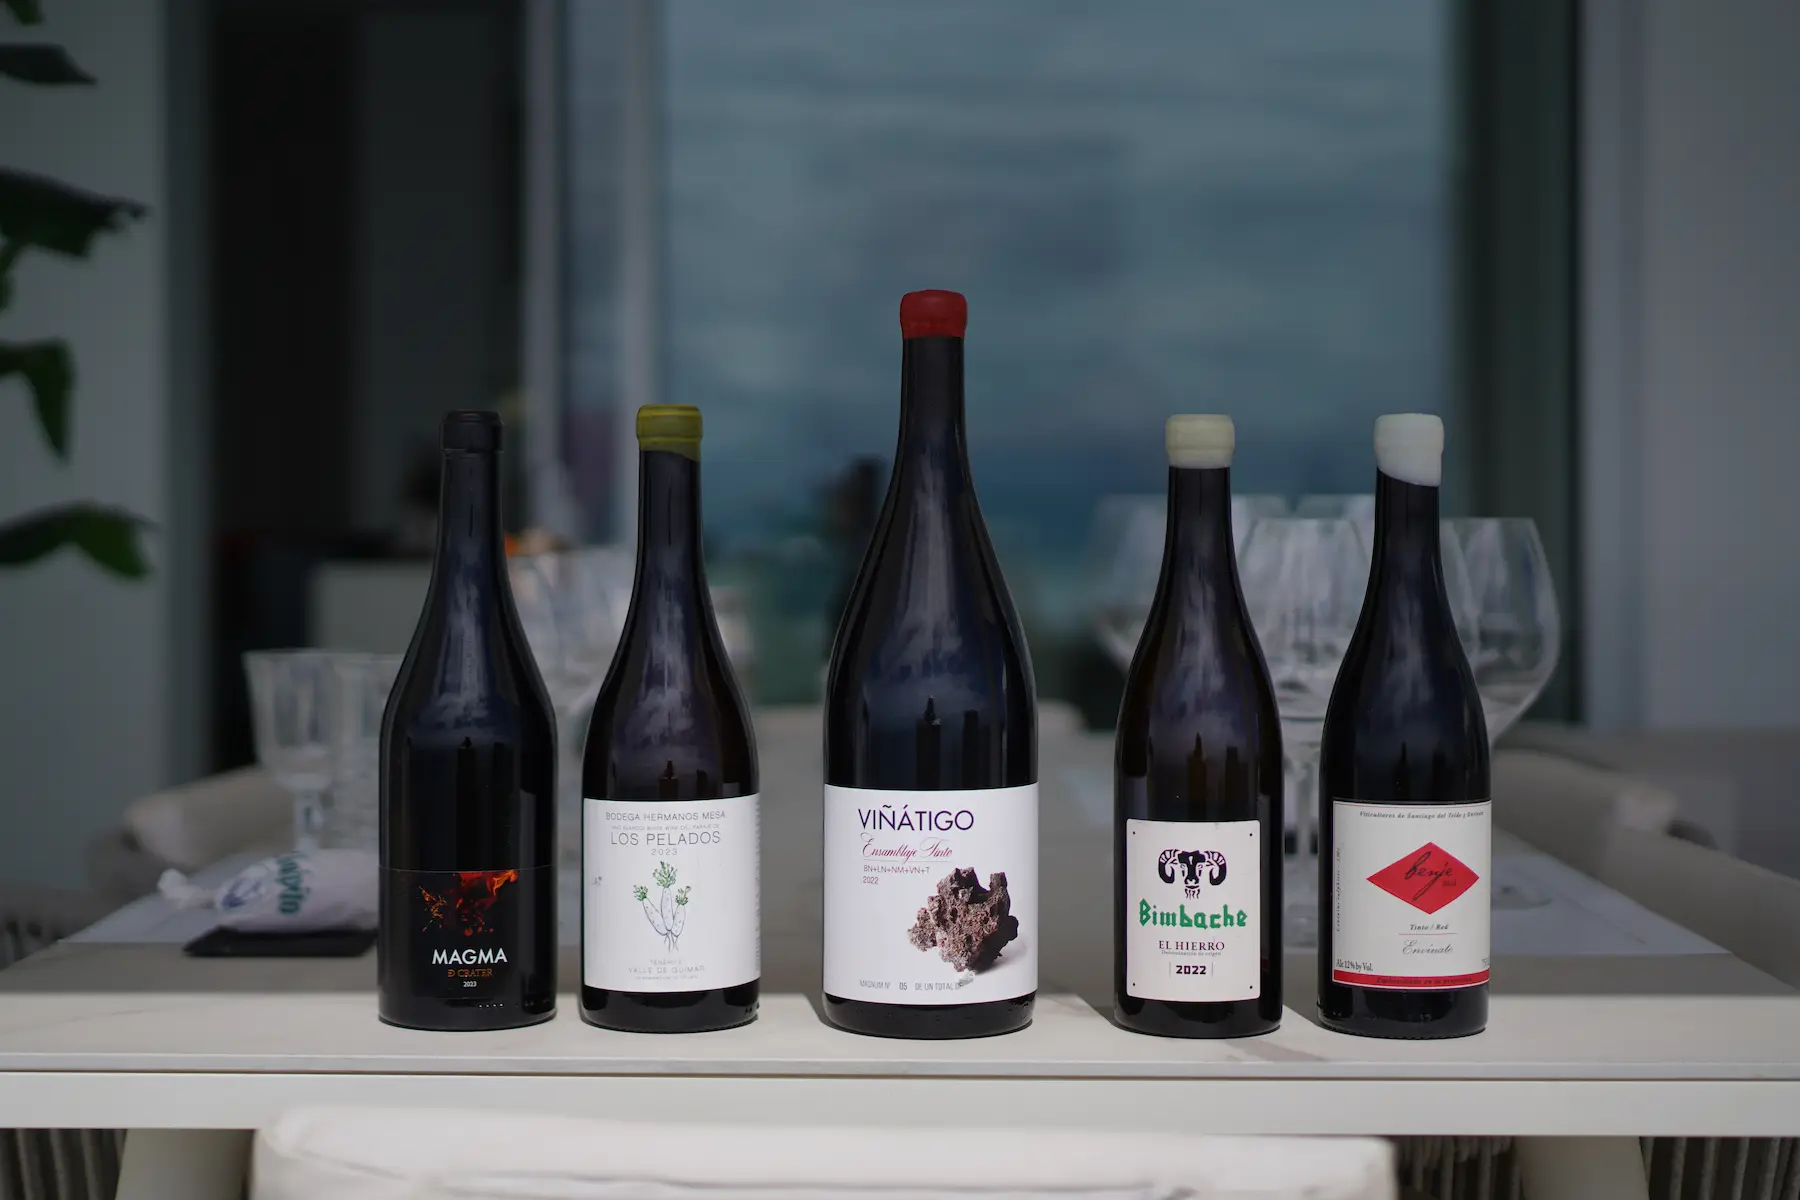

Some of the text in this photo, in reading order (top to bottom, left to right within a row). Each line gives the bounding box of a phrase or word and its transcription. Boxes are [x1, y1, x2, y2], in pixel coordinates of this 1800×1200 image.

[605, 810, 726, 821] BODEGA HERMANOS MESA
[857, 804, 975, 831] VIÑÁTIGO
[610, 830, 721, 846] LOS PELADOS
[650, 848, 678, 856] 2023
[860, 832, 953, 865] Ensamblaje Tinto
[863, 864, 930, 874] BN+LN+NM+VN+T
[862, 875, 879, 885] 2022
[1139, 898, 1248, 930] Bimbache
[1409, 923, 1428, 931] Tinto
[1435, 923, 1448, 931] Red
[1158, 940, 1225, 951] EL HIERRO
[432, 947, 508, 965] MAGMA
[628, 966, 653, 974] VALLE
[656, 966, 668, 974] DE
[1175, 965, 1207, 975] 2022
[1355, 962, 1362, 972] by
[1362, 962, 1374, 972] Vol.
[457, 968, 493, 978] CRATER
[860, 980, 884, 989] MAGNUM
[899, 982, 908, 990] 05
[914, 982, 923, 990] DE
[924, 982, 934, 990] UN
[935, 982, 954, 990] TOTAL
